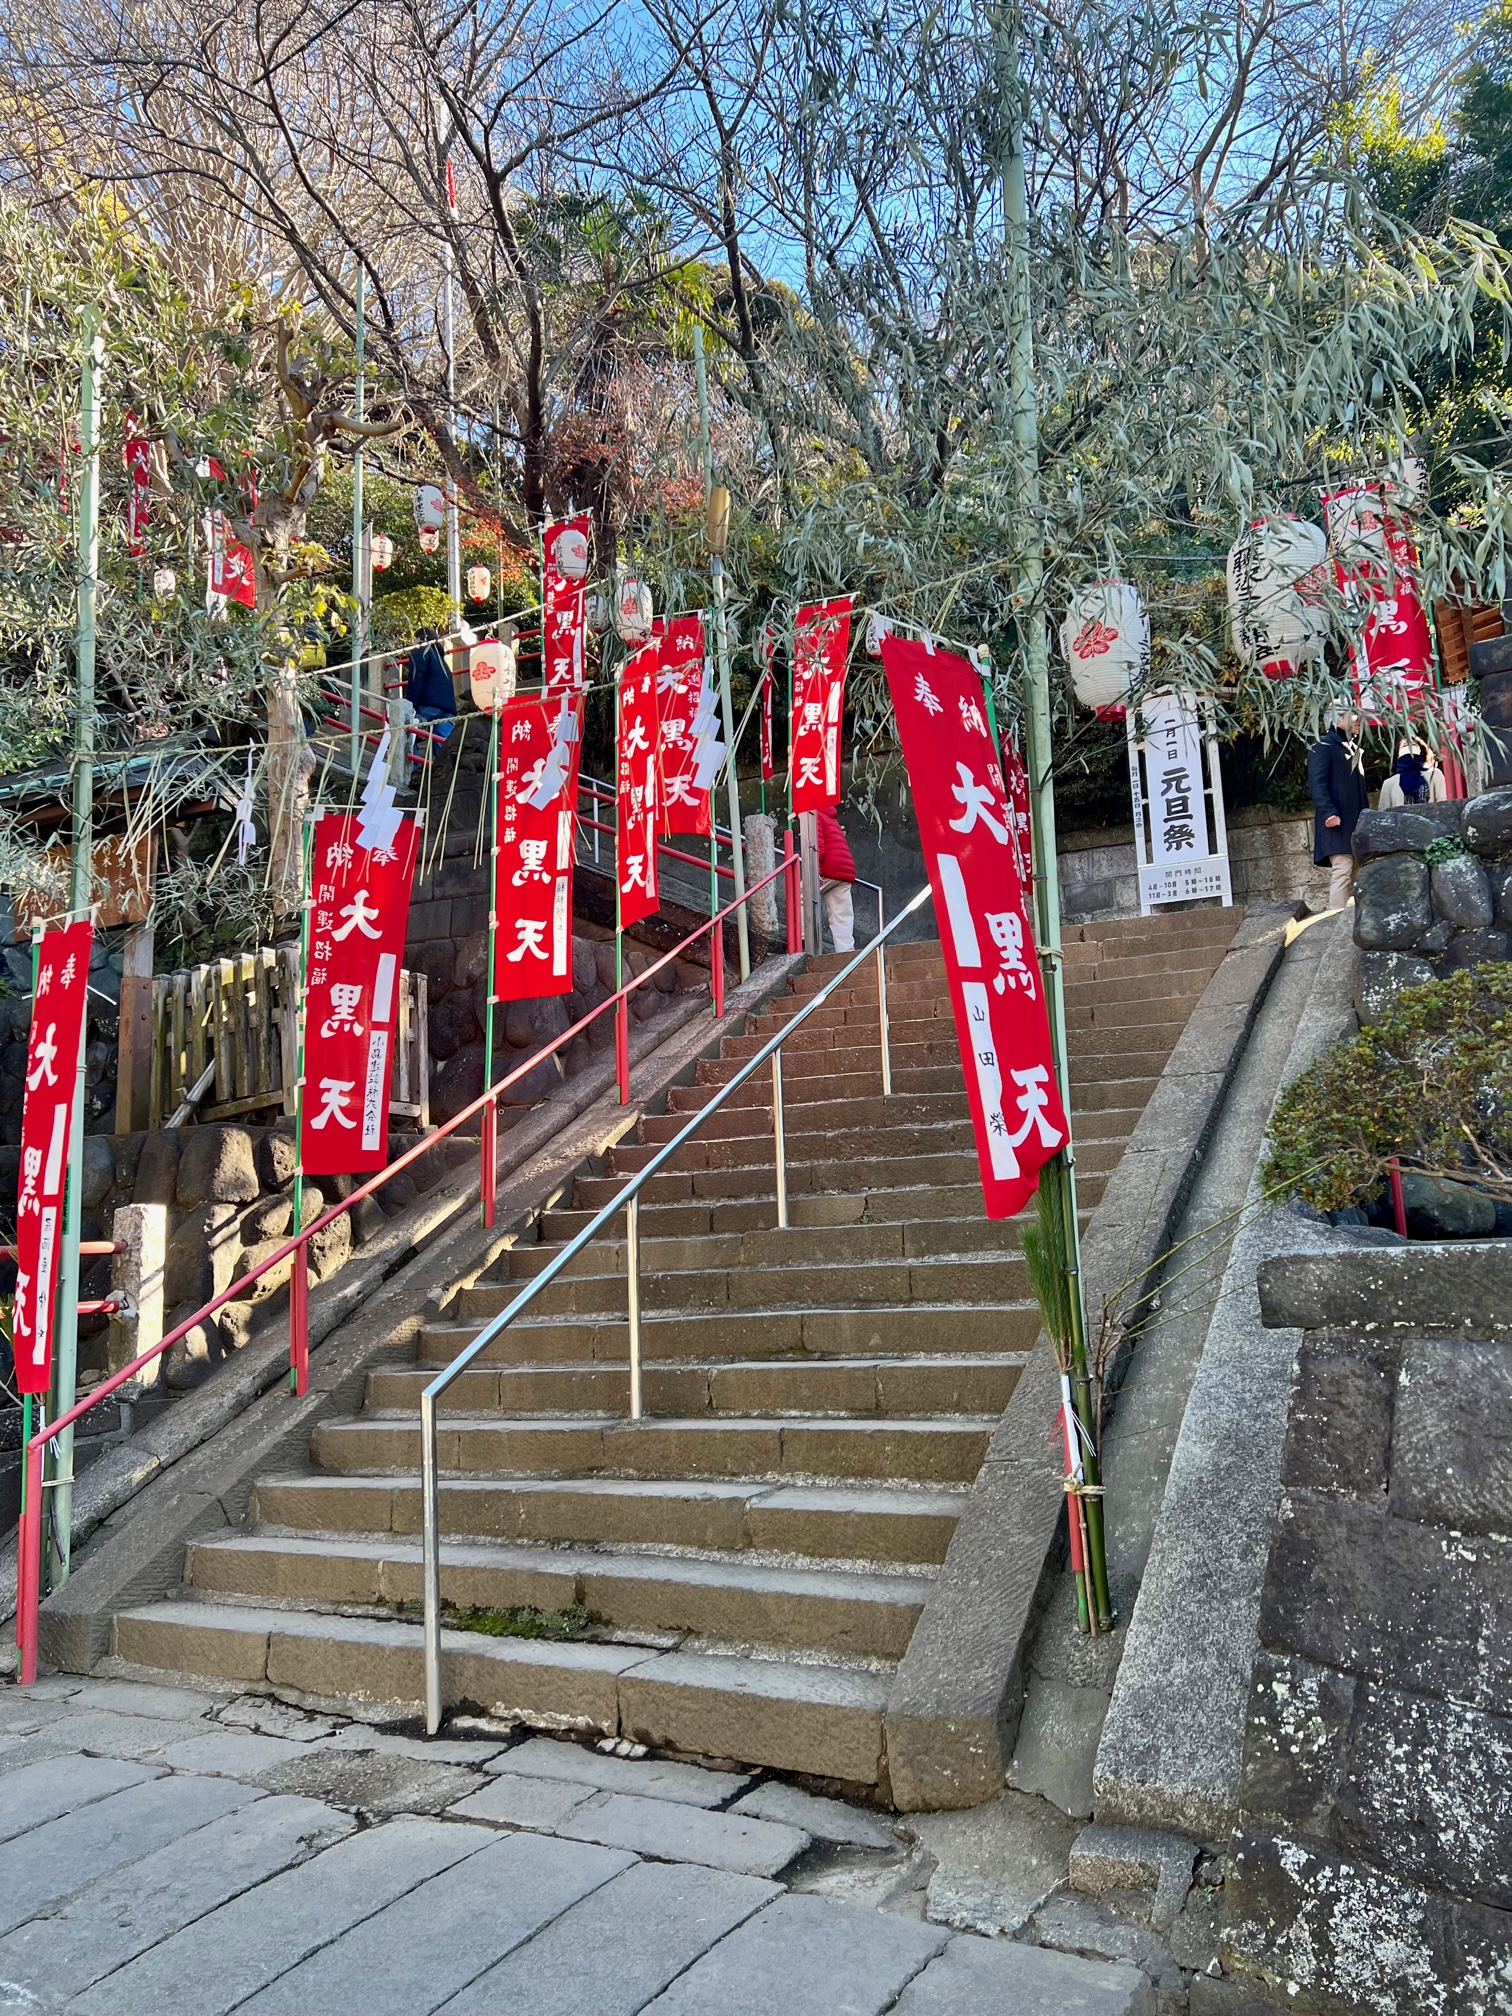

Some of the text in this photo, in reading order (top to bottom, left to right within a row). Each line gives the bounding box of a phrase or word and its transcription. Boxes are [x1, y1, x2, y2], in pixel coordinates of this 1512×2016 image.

[656, 665, 701, 807] 大黒天
[914, 672, 987, 738] 奉納
[1161, 718, 1195, 852] 一月一日 元旦祭
[949, 761, 1063, 1148] 大黒天
